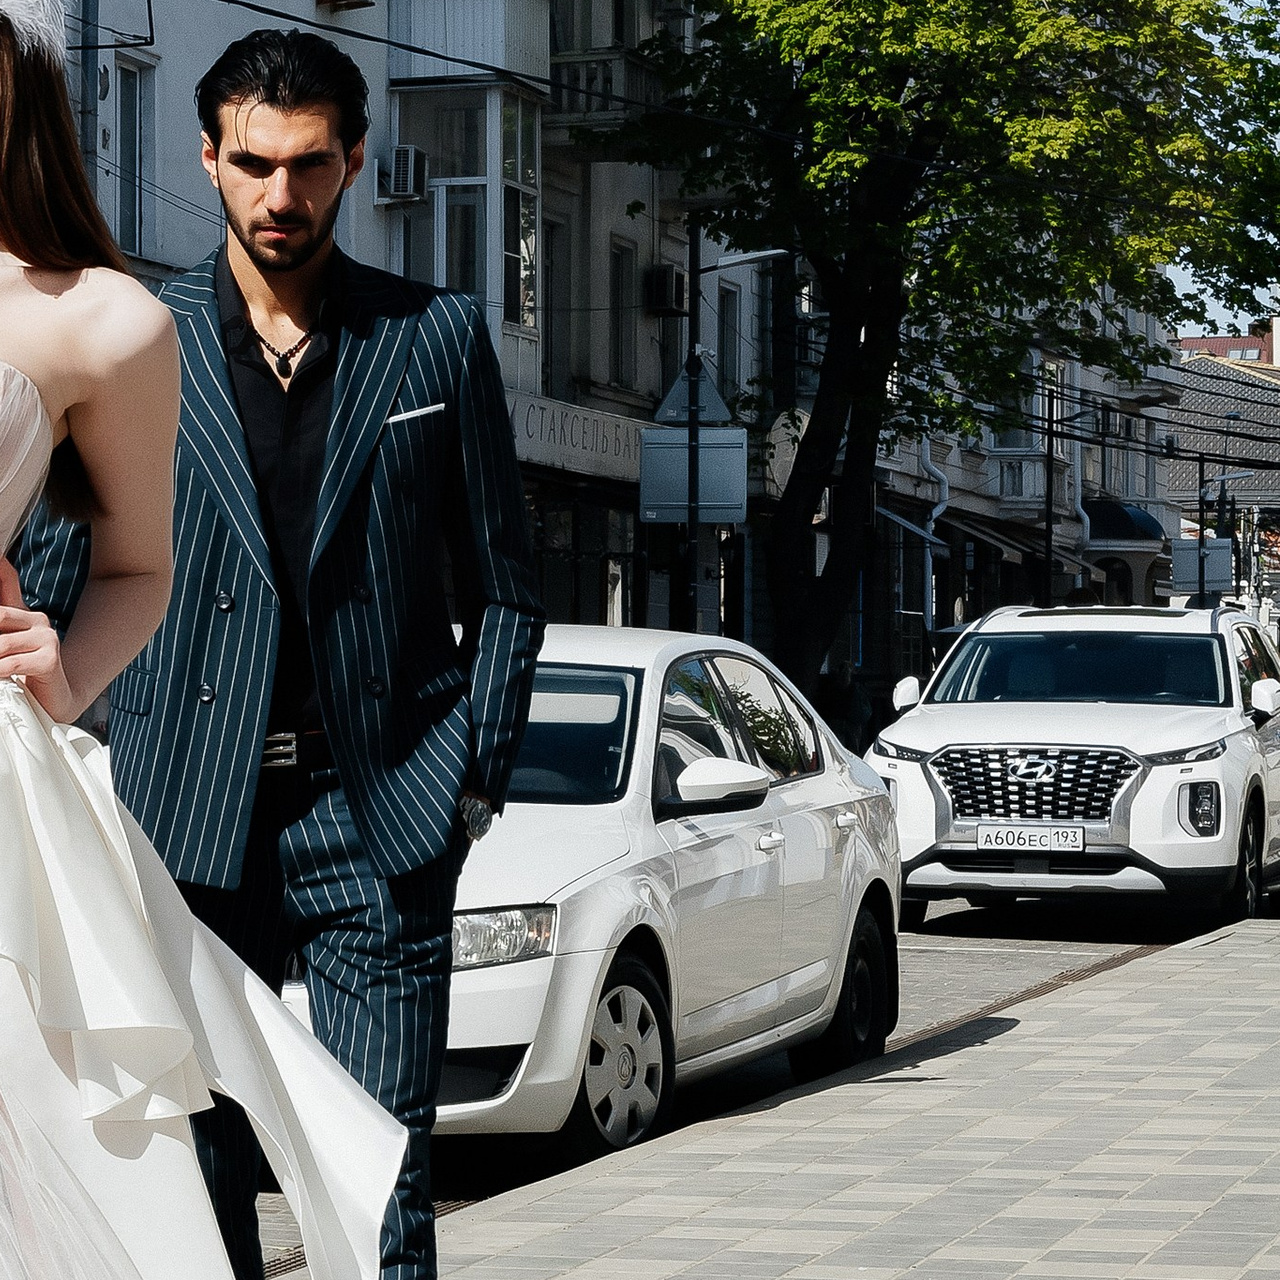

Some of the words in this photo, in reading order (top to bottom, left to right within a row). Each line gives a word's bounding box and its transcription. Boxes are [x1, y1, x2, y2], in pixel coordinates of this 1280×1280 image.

[526, 403, 608, 454] СТАКСЕЛЬ
[983, 830, 1048, 847] А606ЕС
[1053, 830, 1078, 843] 193
